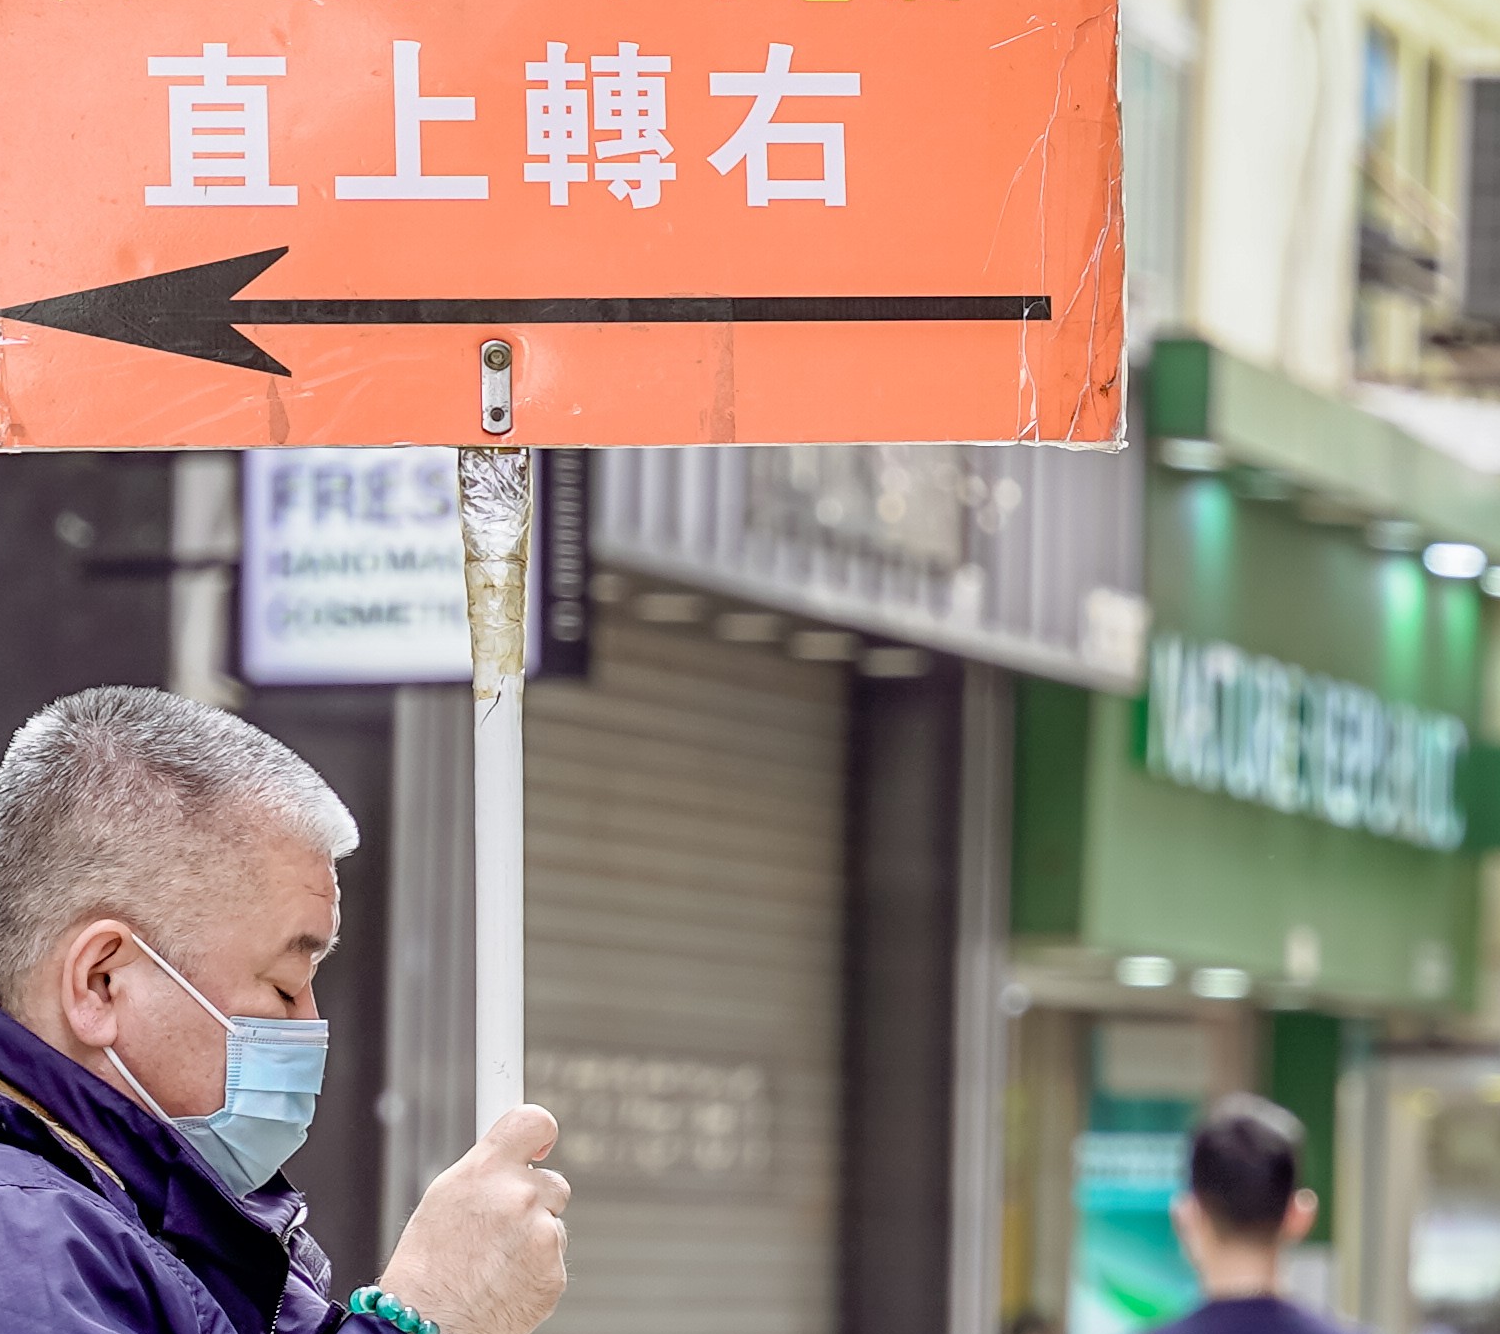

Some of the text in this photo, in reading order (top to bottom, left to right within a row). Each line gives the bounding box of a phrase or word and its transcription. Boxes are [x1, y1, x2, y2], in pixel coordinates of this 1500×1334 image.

[143, 40, 863, 208] 直上轉右
[269, 459, 456, 527] FRES
